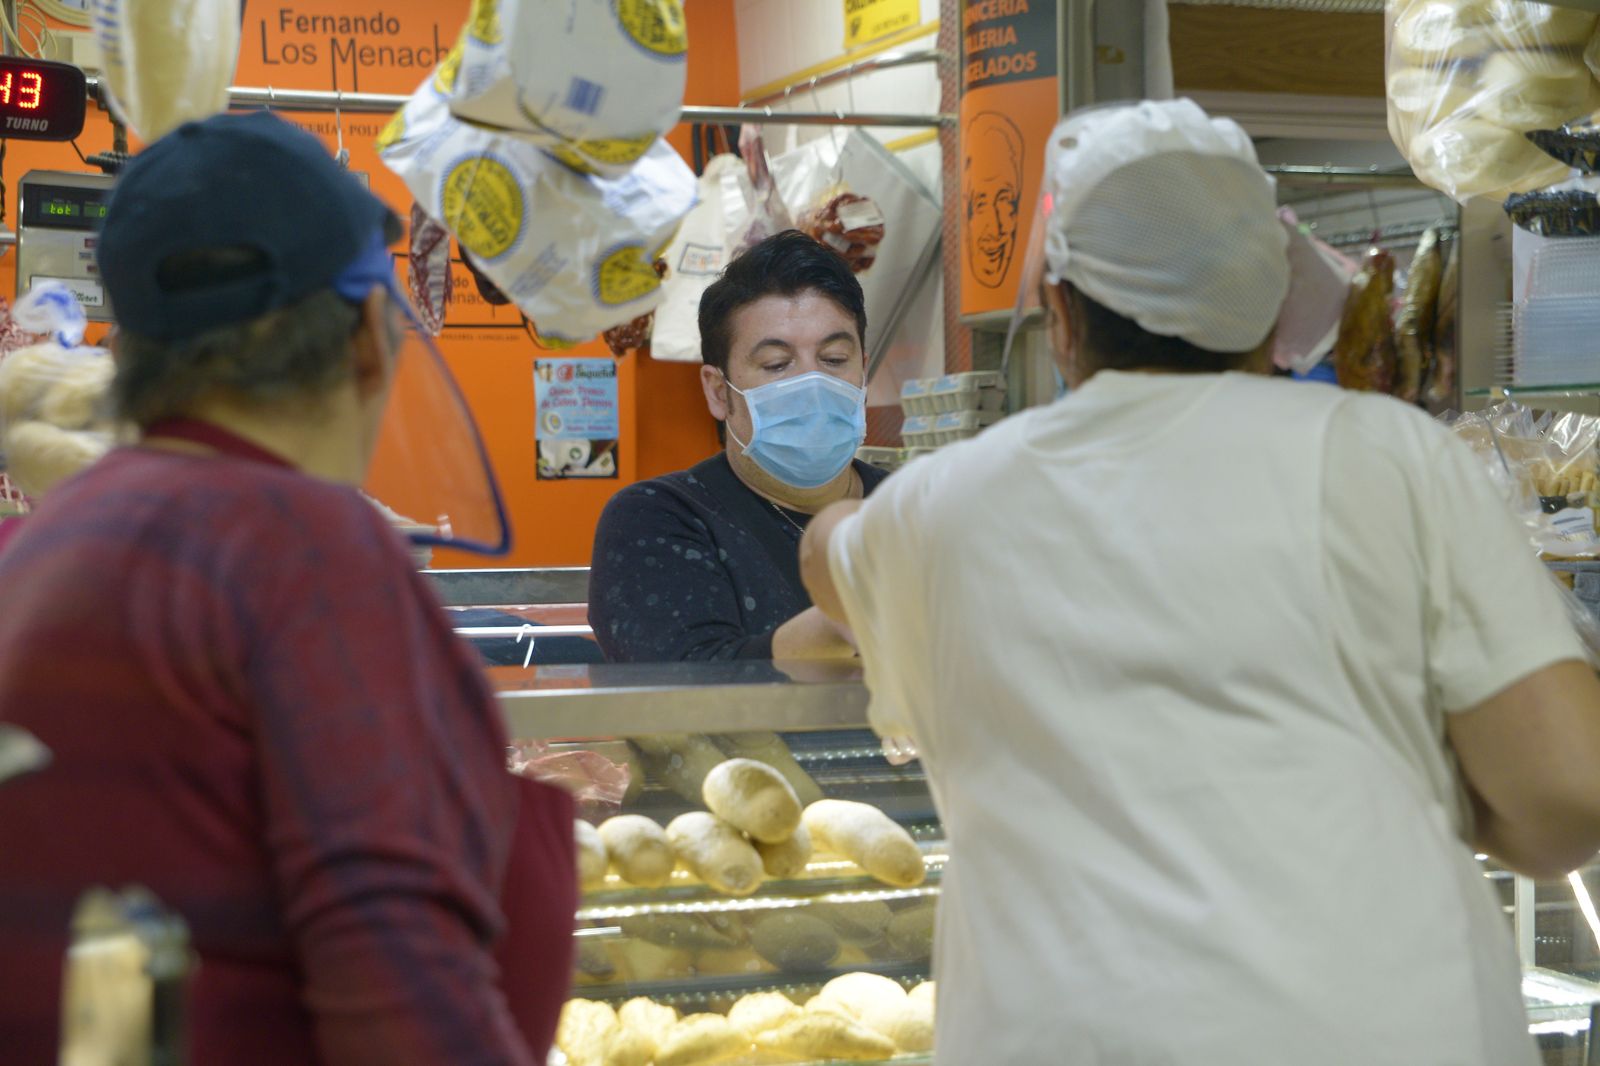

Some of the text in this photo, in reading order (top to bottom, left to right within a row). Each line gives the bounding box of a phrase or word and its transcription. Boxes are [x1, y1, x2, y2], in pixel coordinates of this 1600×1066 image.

[279, 8, 400, 35] Fernando
[261, 19, 318, 65] Los
[6, 116, 49, 131] TURNO
